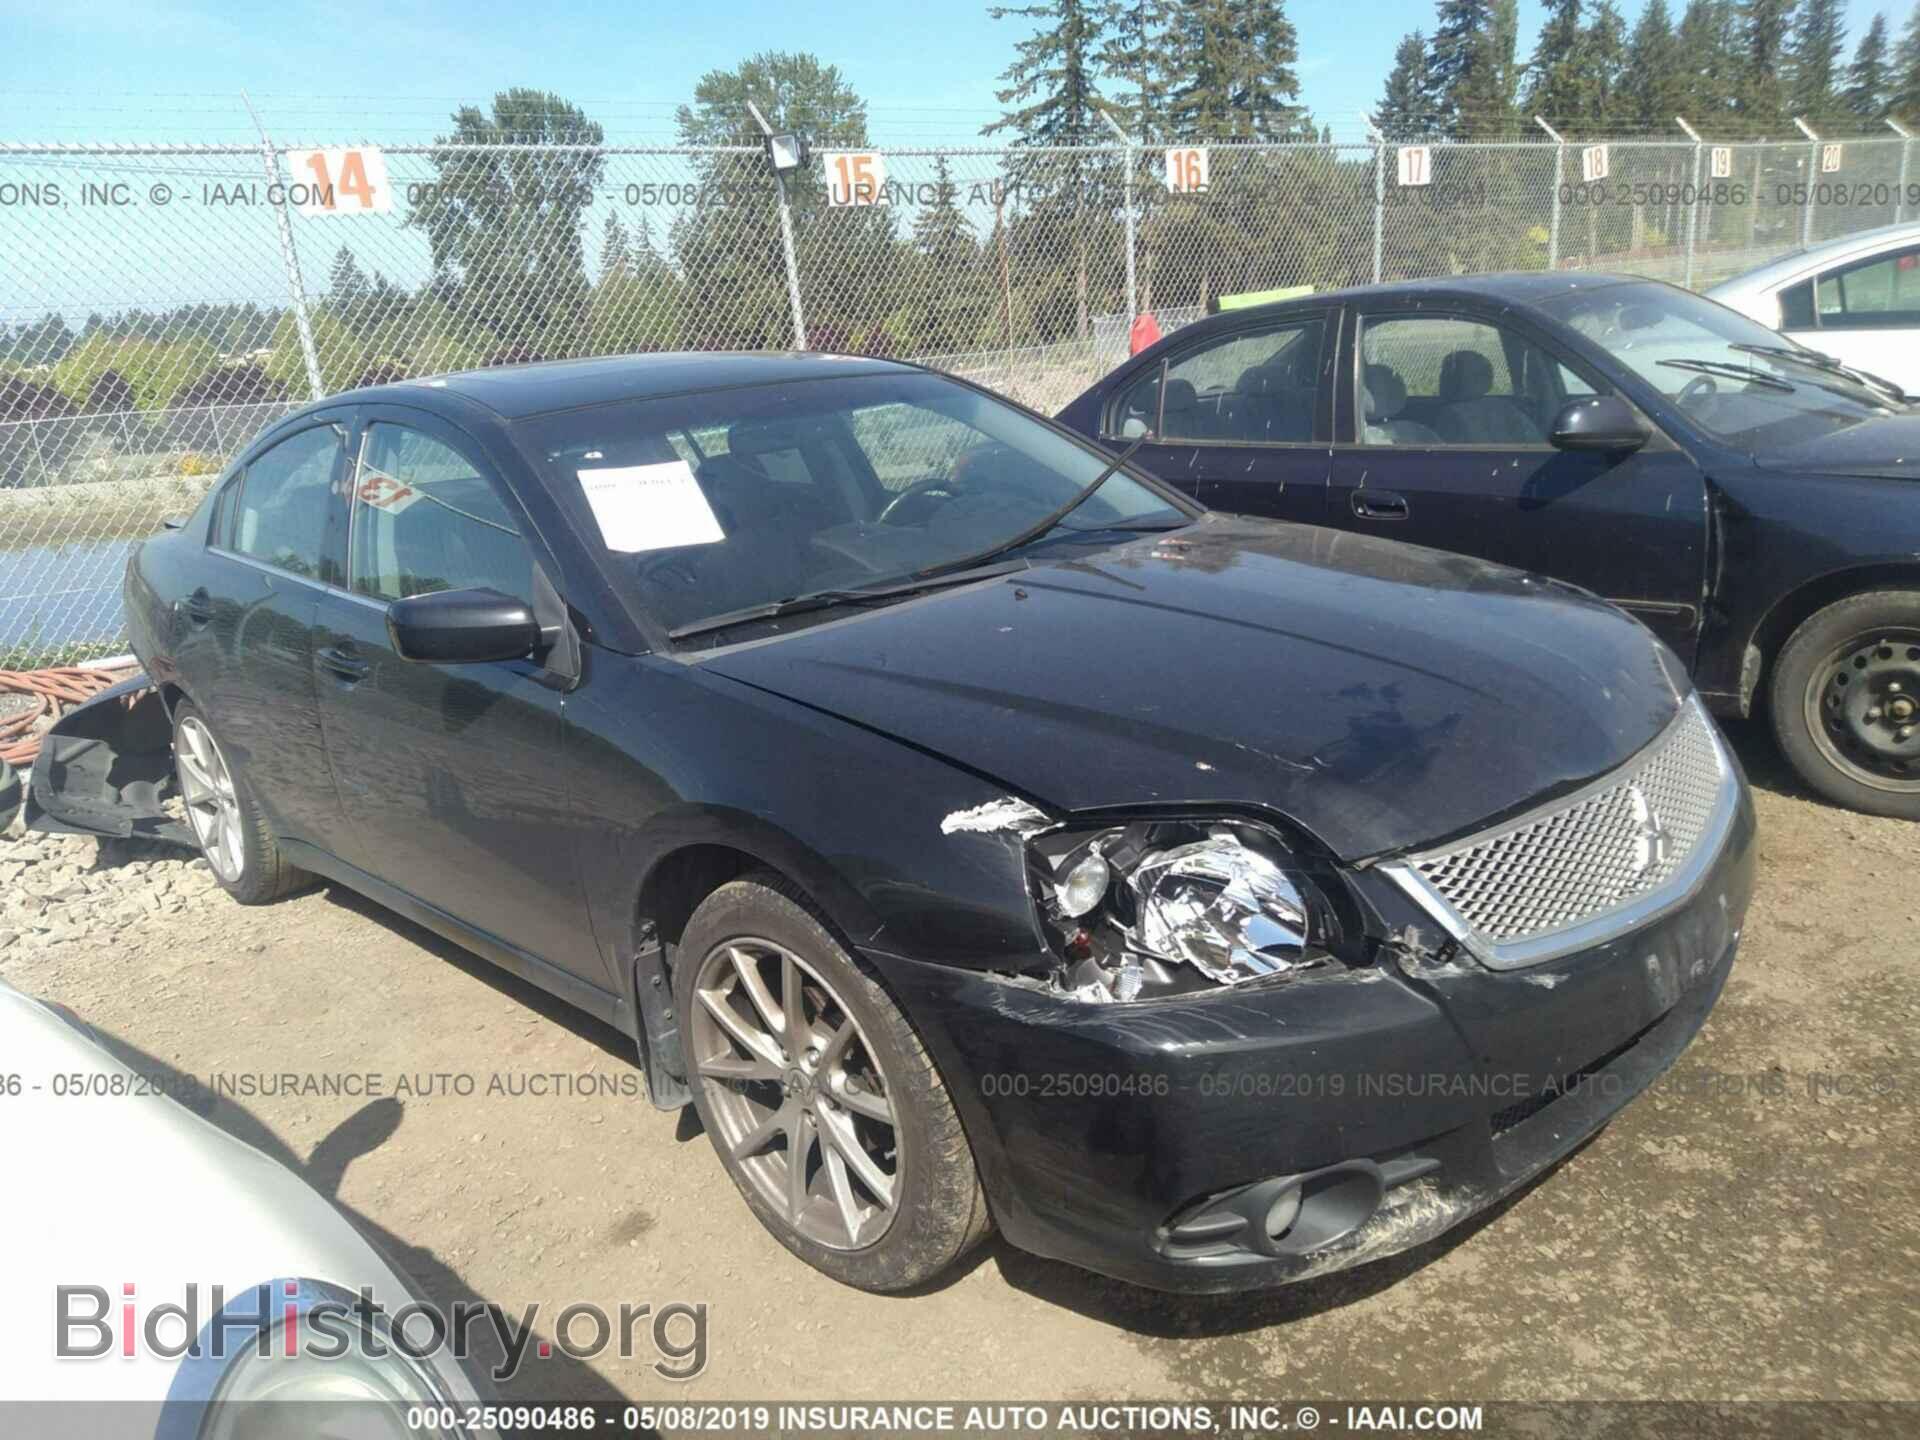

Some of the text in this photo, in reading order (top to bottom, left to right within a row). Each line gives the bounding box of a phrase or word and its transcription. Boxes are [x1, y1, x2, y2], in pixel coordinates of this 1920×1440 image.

[1173, 150, 1201, 191] 16
[1404, 149, 1423, 183] 17
[1587, 148, 1602, 178] 18
[1715, 149, 1727, 175] 19
[1824, 146, 1839, 171] 20
[306, 152, 376, 210] 14
[835, 156, 876, 203] 15
